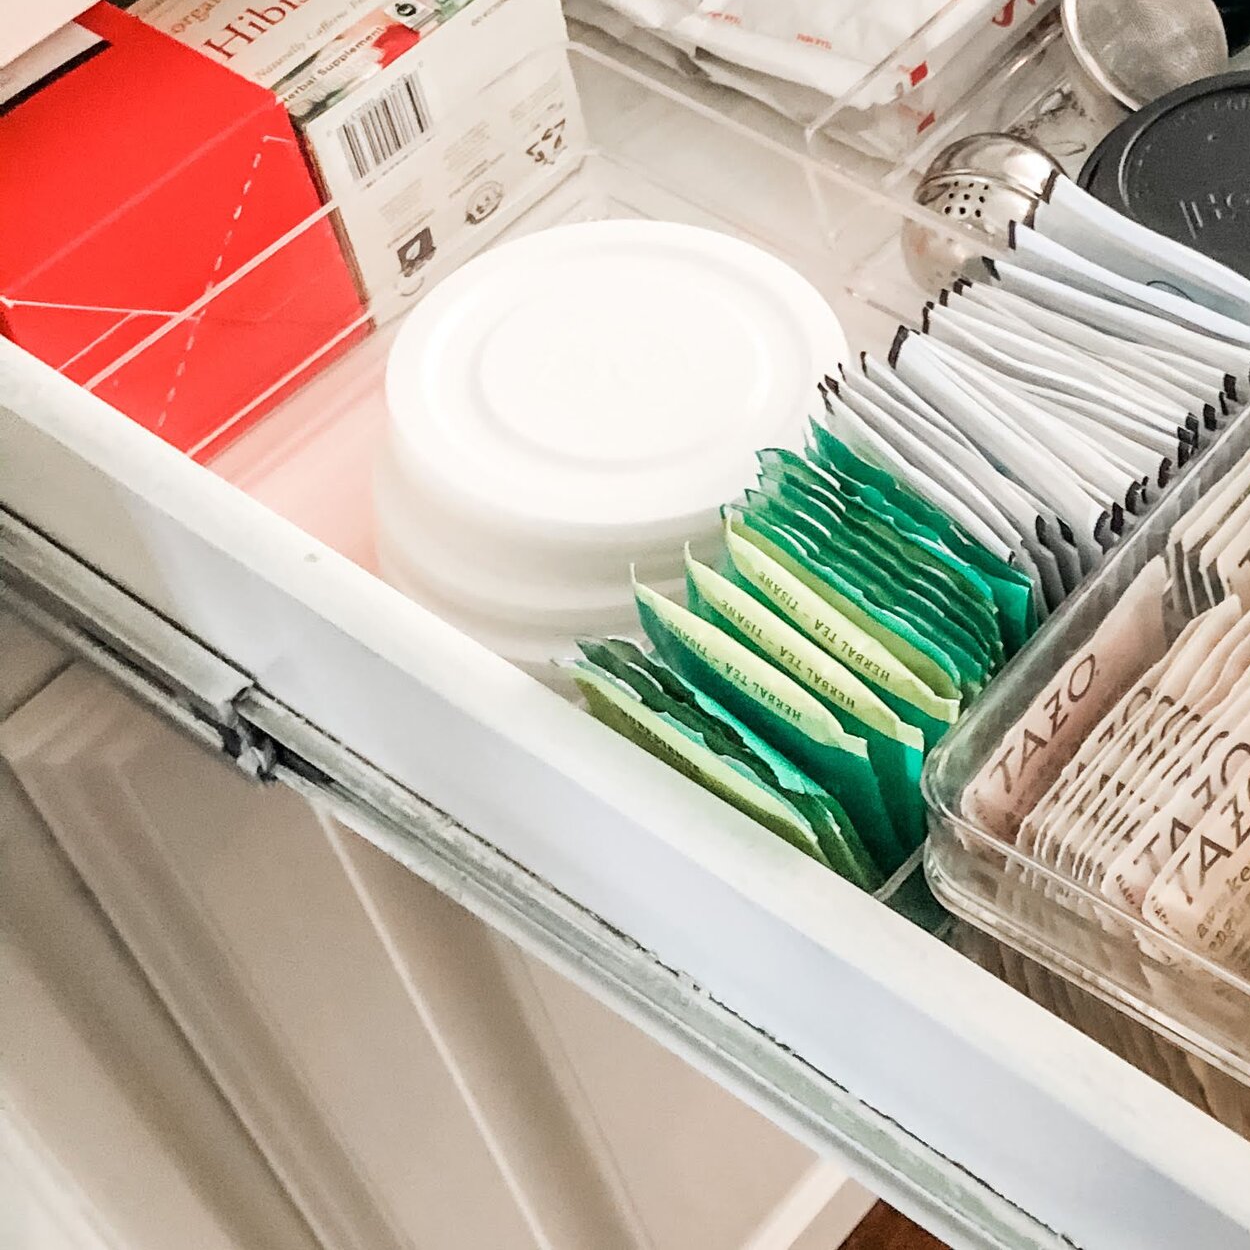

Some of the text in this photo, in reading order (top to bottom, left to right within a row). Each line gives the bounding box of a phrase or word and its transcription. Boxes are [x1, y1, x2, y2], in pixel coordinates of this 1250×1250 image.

[253, 41, 307, 80] Naturally
[306, 9, 349, 44] Caffeine
[317, 25, 386, 78] Supplement
[758, 570, 799, 612] TISANE
[719, 599, 763, 641] TISANE
[814, 618, 838, 643] TEA
[724, 662, 749, 688] TEA
[779, 644, 803, 671] TEA
[841, 637, 891, 683] HERBAL
[751, 681, 803, 722] HERBAL
[806, 667, 856, 710] HERBAL
[989, 653, 1096, 795] TAZO
